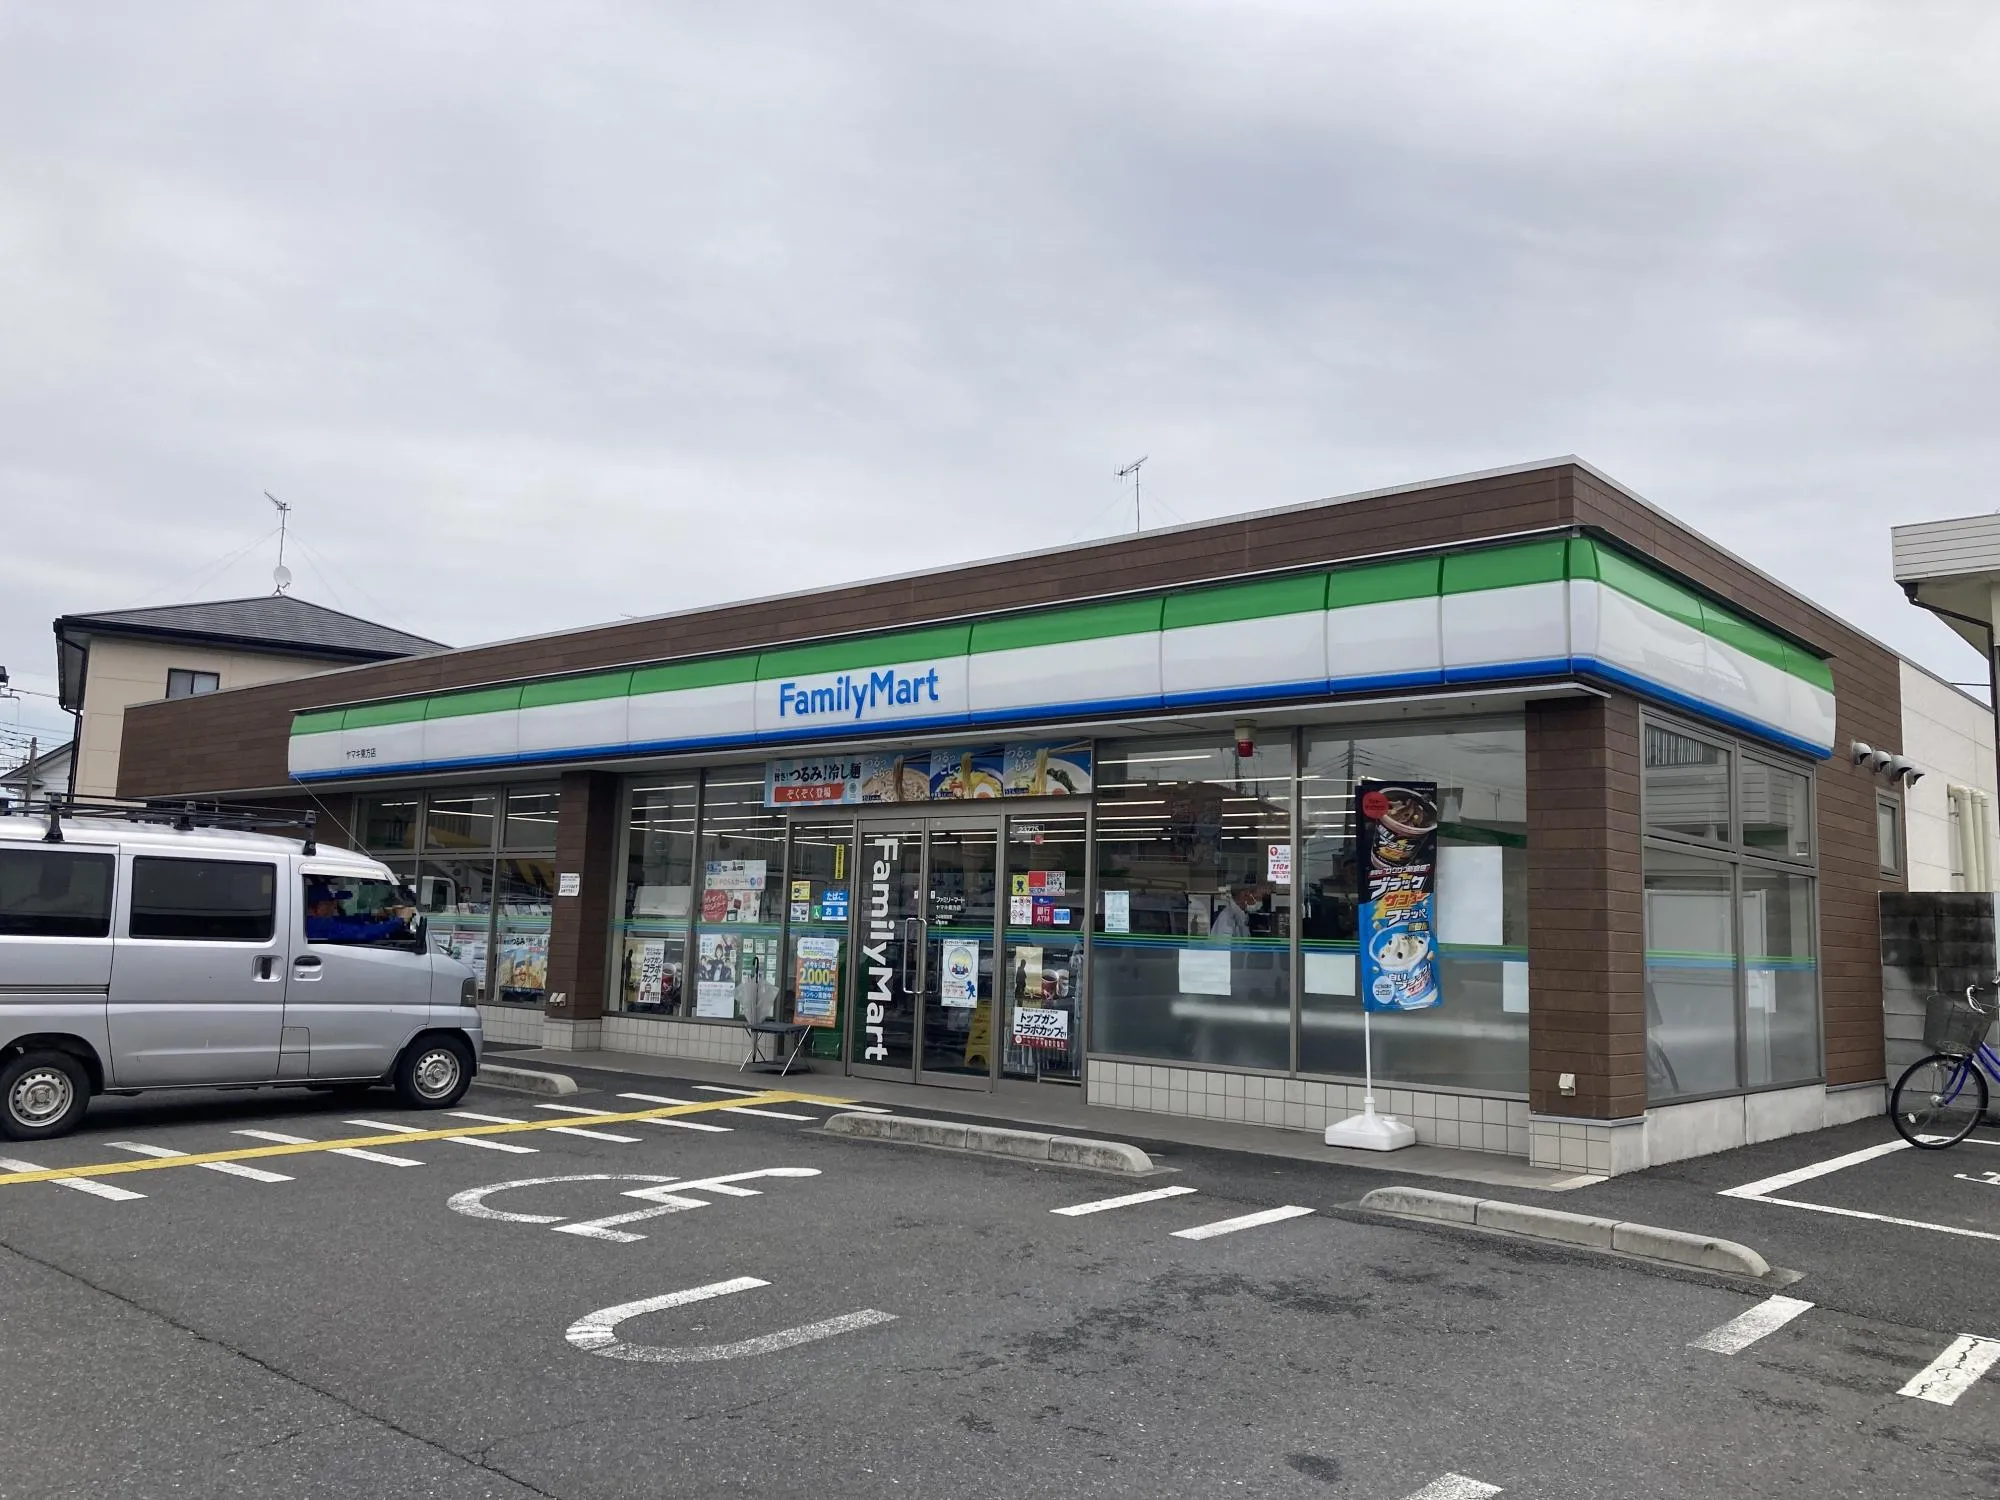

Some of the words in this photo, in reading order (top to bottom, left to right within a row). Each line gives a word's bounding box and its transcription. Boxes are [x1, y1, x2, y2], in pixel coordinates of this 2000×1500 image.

[780, 667, 939, 719] FamilyMart
[826, 892, 844, 901] たばこ
[1368, 875, 1427, 901] ブラック
[1036, 915, 1051, 923] ATM
[1385, 908, 1428, 928] フラッペ
[863, 838, 899, 1062] FamilyMart
[1020, 1012, 1058, 1025] トップガン
